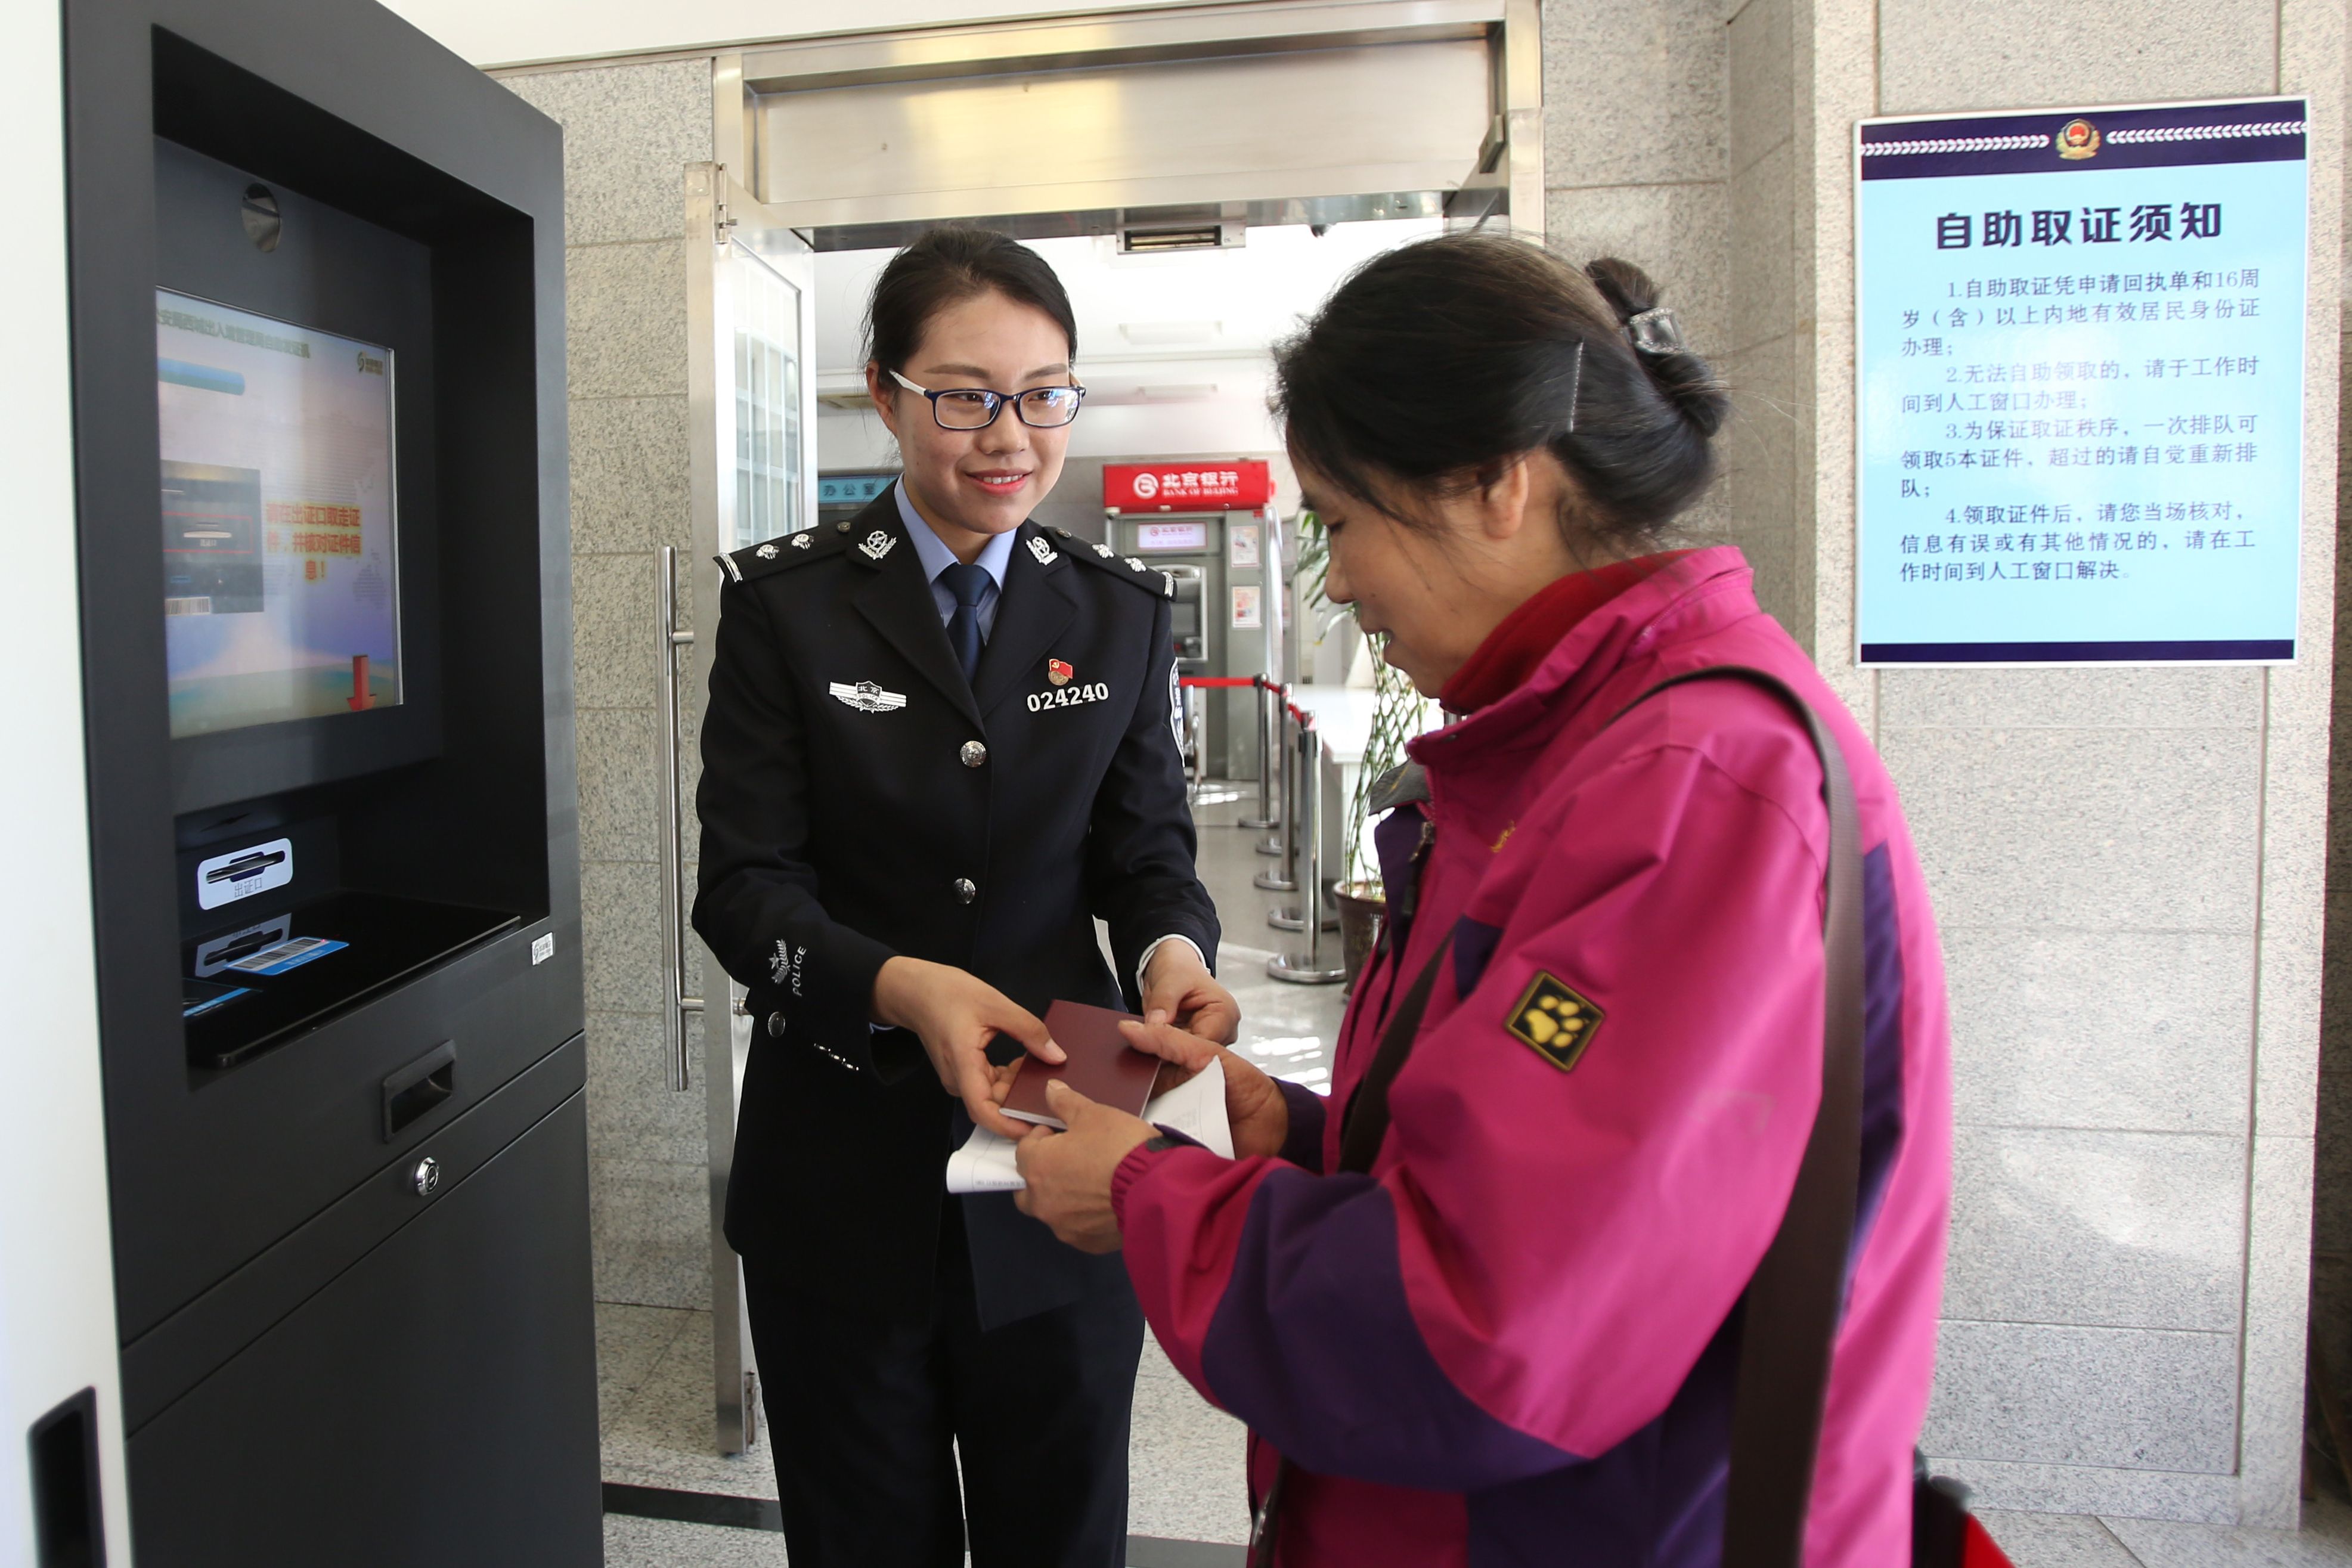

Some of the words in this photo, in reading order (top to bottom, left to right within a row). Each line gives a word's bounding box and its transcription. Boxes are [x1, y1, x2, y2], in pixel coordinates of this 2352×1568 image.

[1936, 202, 2222, 249] 自助取证须知
[1948, 268, 2260, 298] 1.自助取证凭申请回执单和16周
[1902, 337, 1953, 357] 办理；
[1902, 390, 2086, 413] 间到人工窗口办理；
[1946, 414, 2258, 440] 3.为保证取证秩序，一次排队可
[823, 483, 875, 497] 办公室
[1162, 471, 1238, 487] 北京银行
[1901, 479, 1930, 498] 队；
[1164, 488, 1188, 496] BANK
[1203, 486, 1238, 495] BEIJING
[1900, 530, 2255, 554] 信息有误或有其他情况的，请在工
[1900, 560, 2129, 582] 作时间到人工窗口解决。
[859, 686, 879, 694] 北京
[1027, 683, 1109, 712] 024240
[234, 878, 262, 898] 出证口
[792, 946, 807, 997] POLICE
